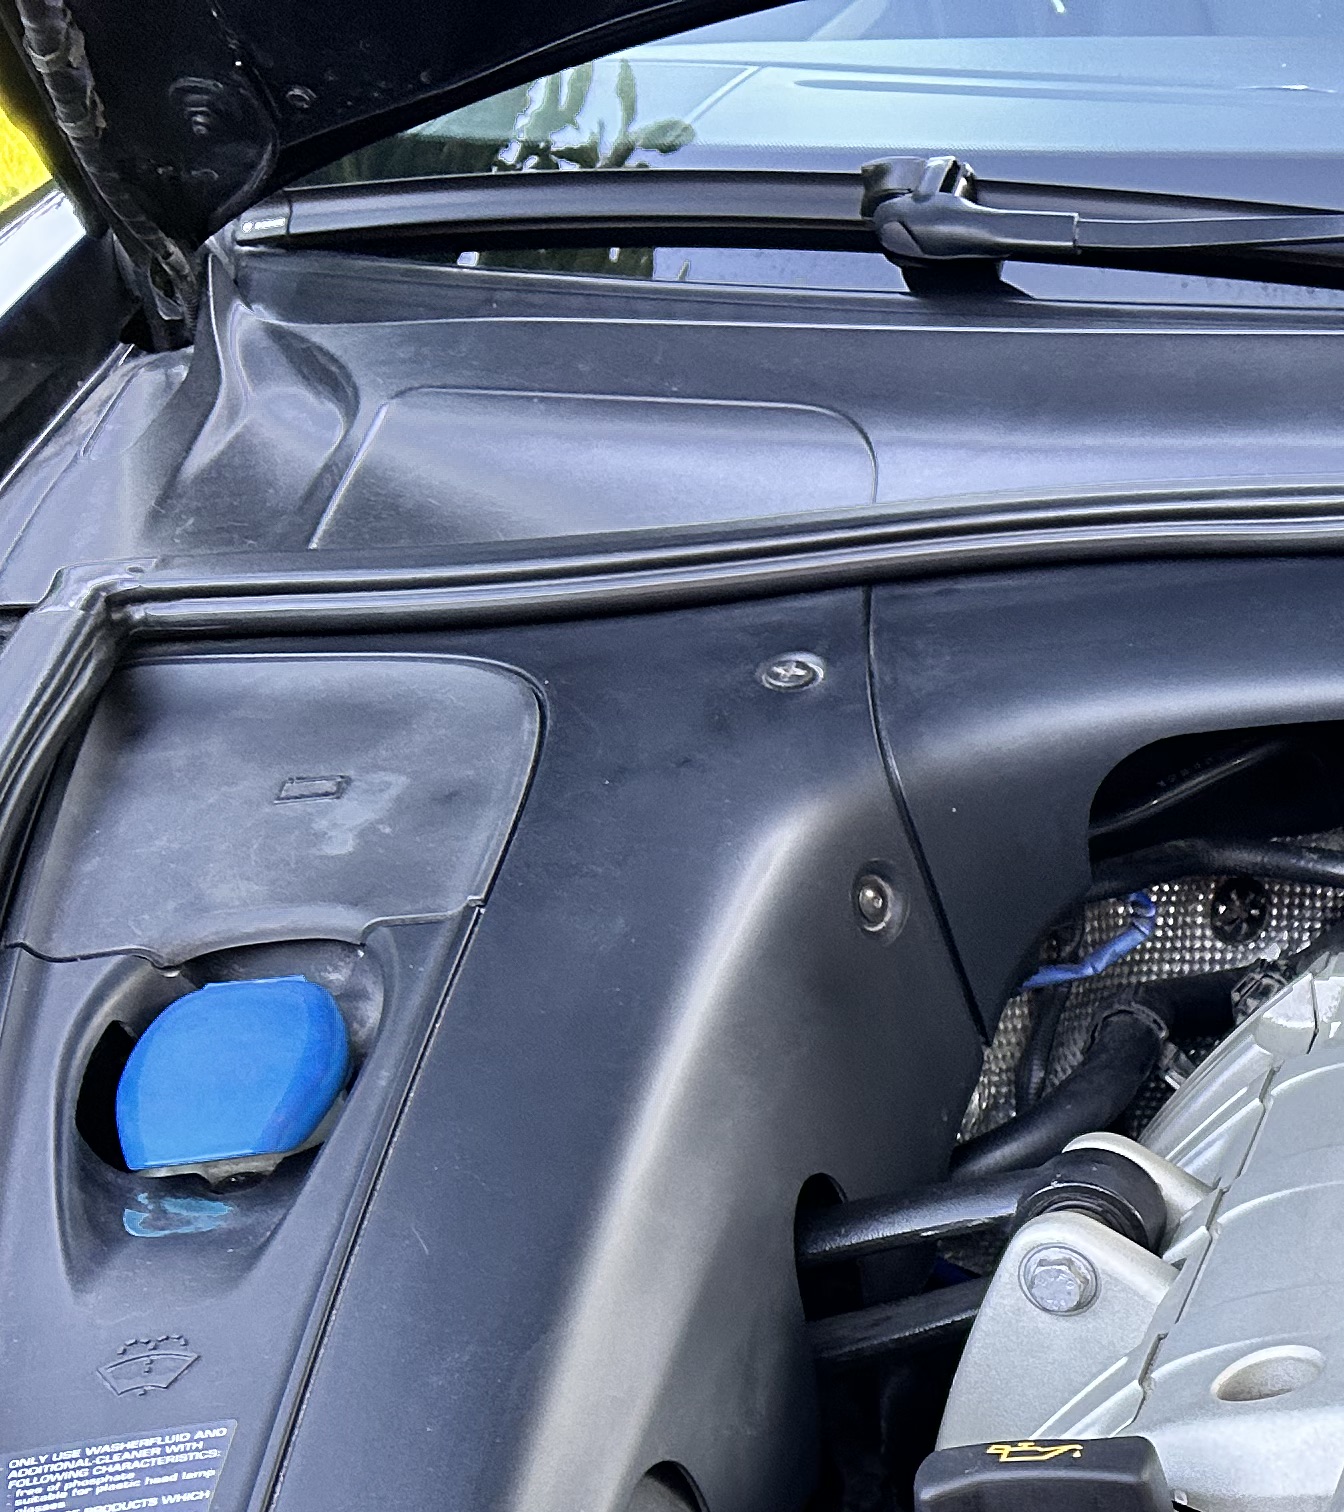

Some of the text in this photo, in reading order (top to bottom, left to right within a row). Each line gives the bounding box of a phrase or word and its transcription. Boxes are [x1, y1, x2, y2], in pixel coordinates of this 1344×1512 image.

[9, 1454, 49, 1469] ONLY
[52, 1448, 81, 1462] USE
[193, 1427, 228, 1440] AND
[165, 1440, 204, 1454] WITH
[7, 1448, 222, 1490] FOLLOWING CHARACTERISTICS:
[47, 1481, 61, 1492] of
[161, 1489, 211, 1505] WHICH
